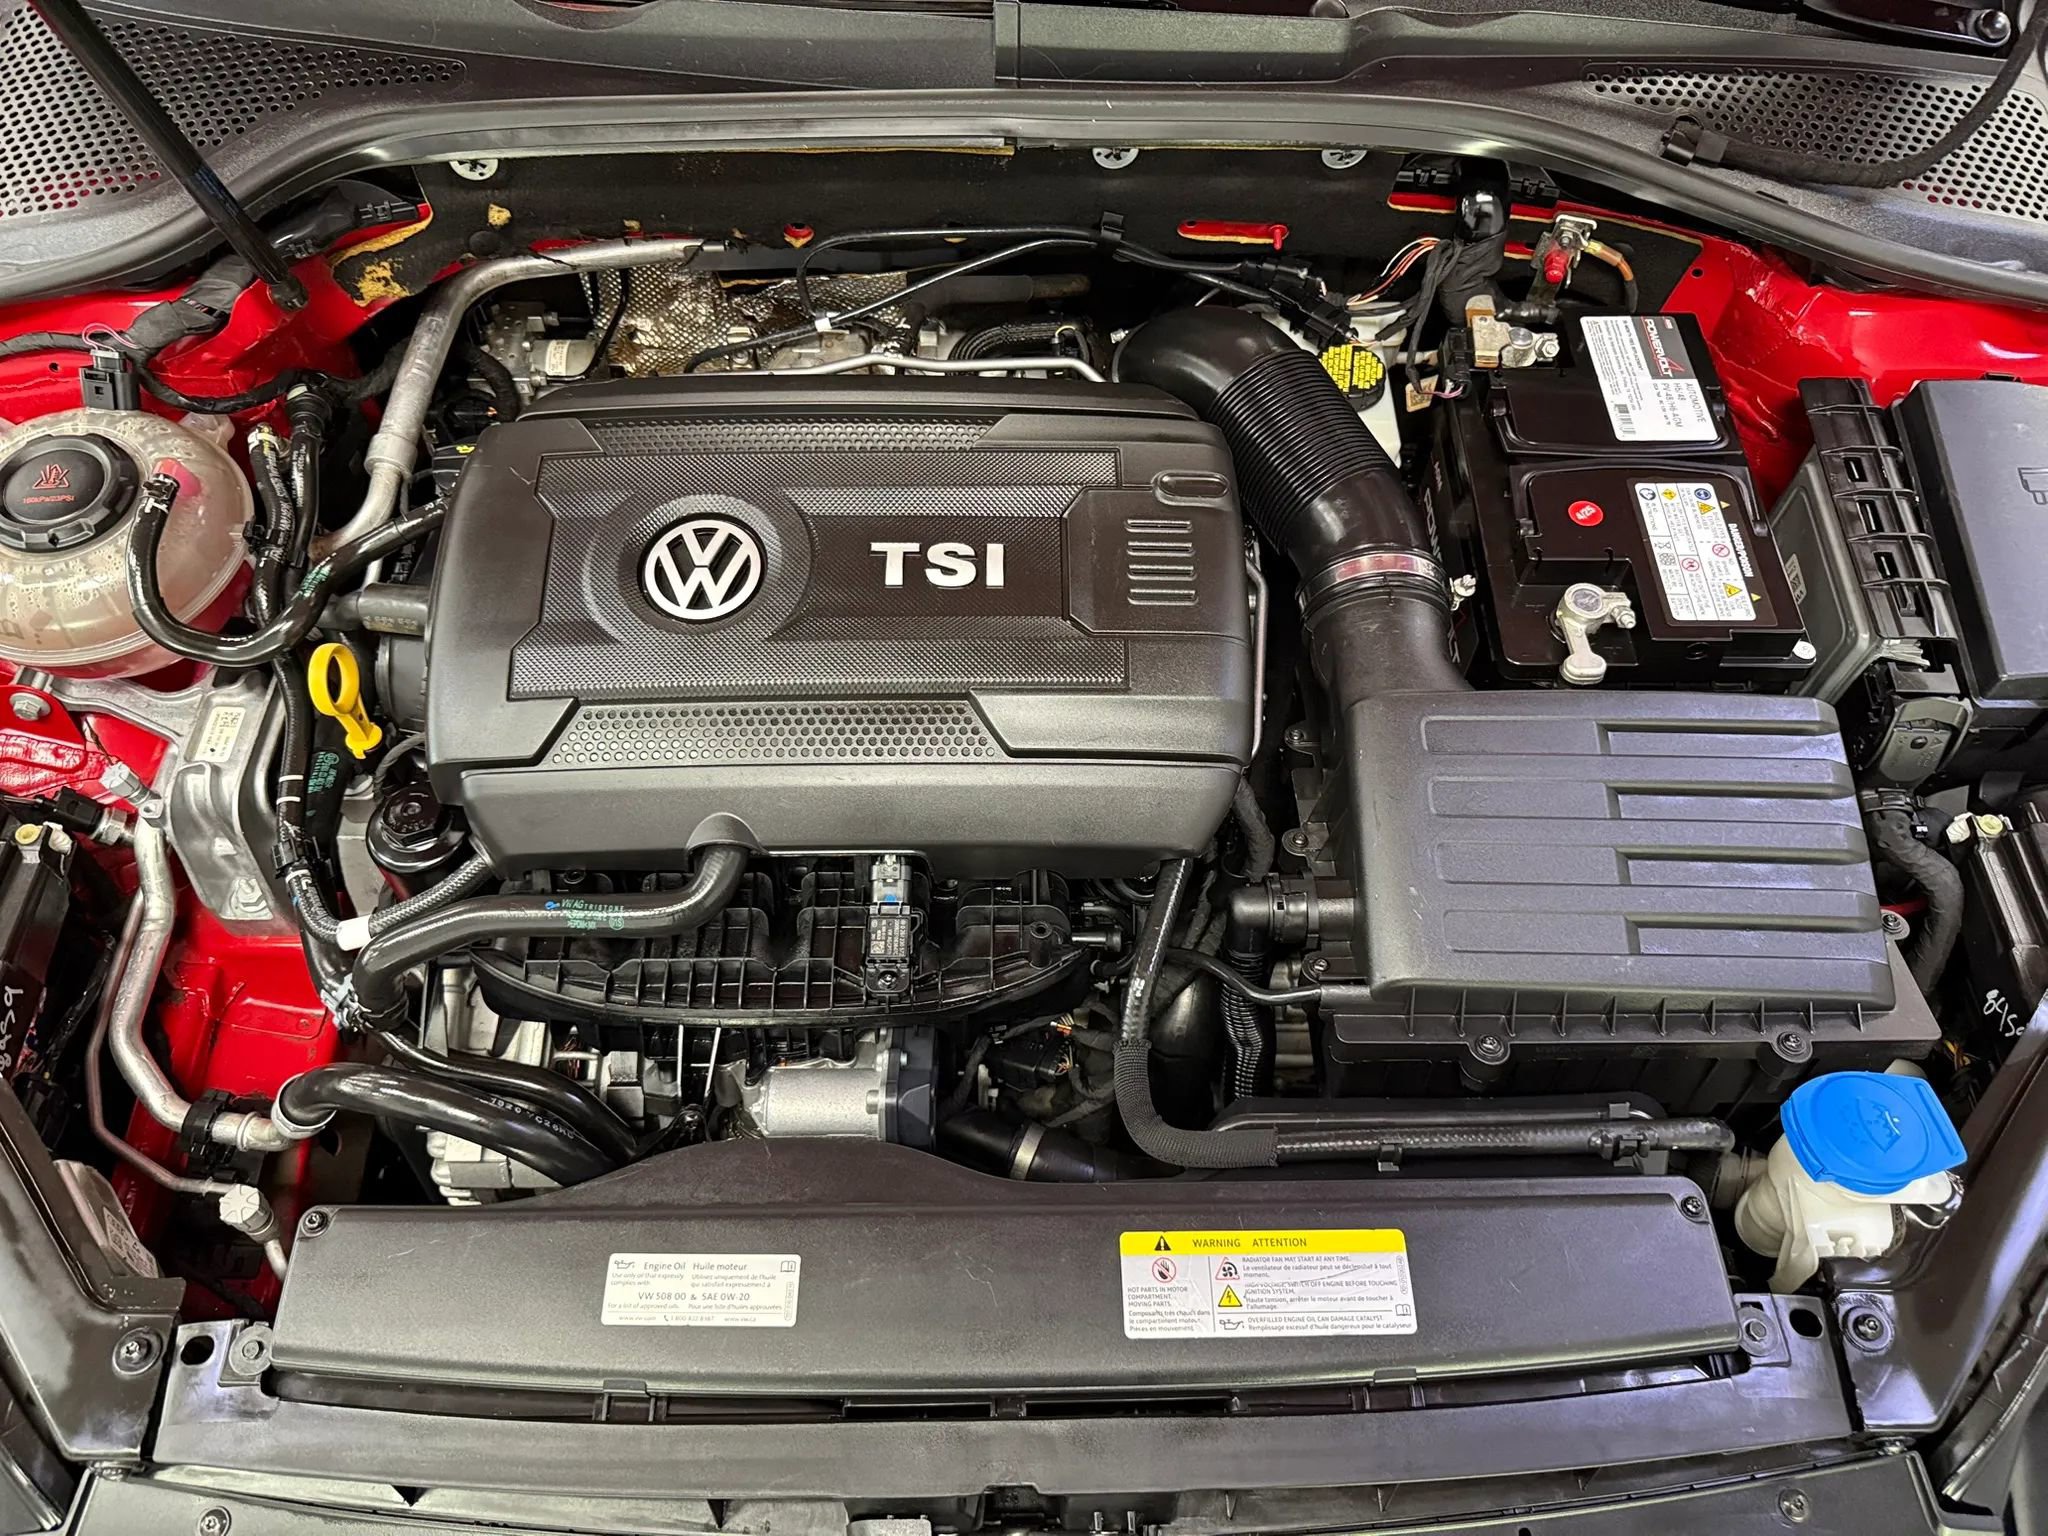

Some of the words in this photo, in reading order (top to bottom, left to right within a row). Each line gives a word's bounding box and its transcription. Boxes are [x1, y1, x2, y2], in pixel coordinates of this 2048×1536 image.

[1643, 318, 1673, 377] POWERVOLT
[1683, 382, 1707, 422] AUTOMOTIVE
[644, 519, 762, 620] VW
[870, 542, 1004, 588] TSI
[1726, 523, 1754, 577] DANGER/POISON
[1193, 1238, 1241, 1248] WARNING
[1252, 1238, 1307, 1247] ATTENTION
[644, 1262, 672, 1272] Engine
[673, 1262, 686, 1270] Oil
[693, 1262, 715, 1271] Huile
[716, 1263, 748, 1271] moteur
[638, 1292, 654, 1300] VW
[656, 1292, 672, 1301] 508
[674, 1292, 687, 1301] 00
[690, 1293, 697, 1301] &
[702, 1293, 718, 1301] SAE
[720, 1293, 750, 1301] 0W-20
